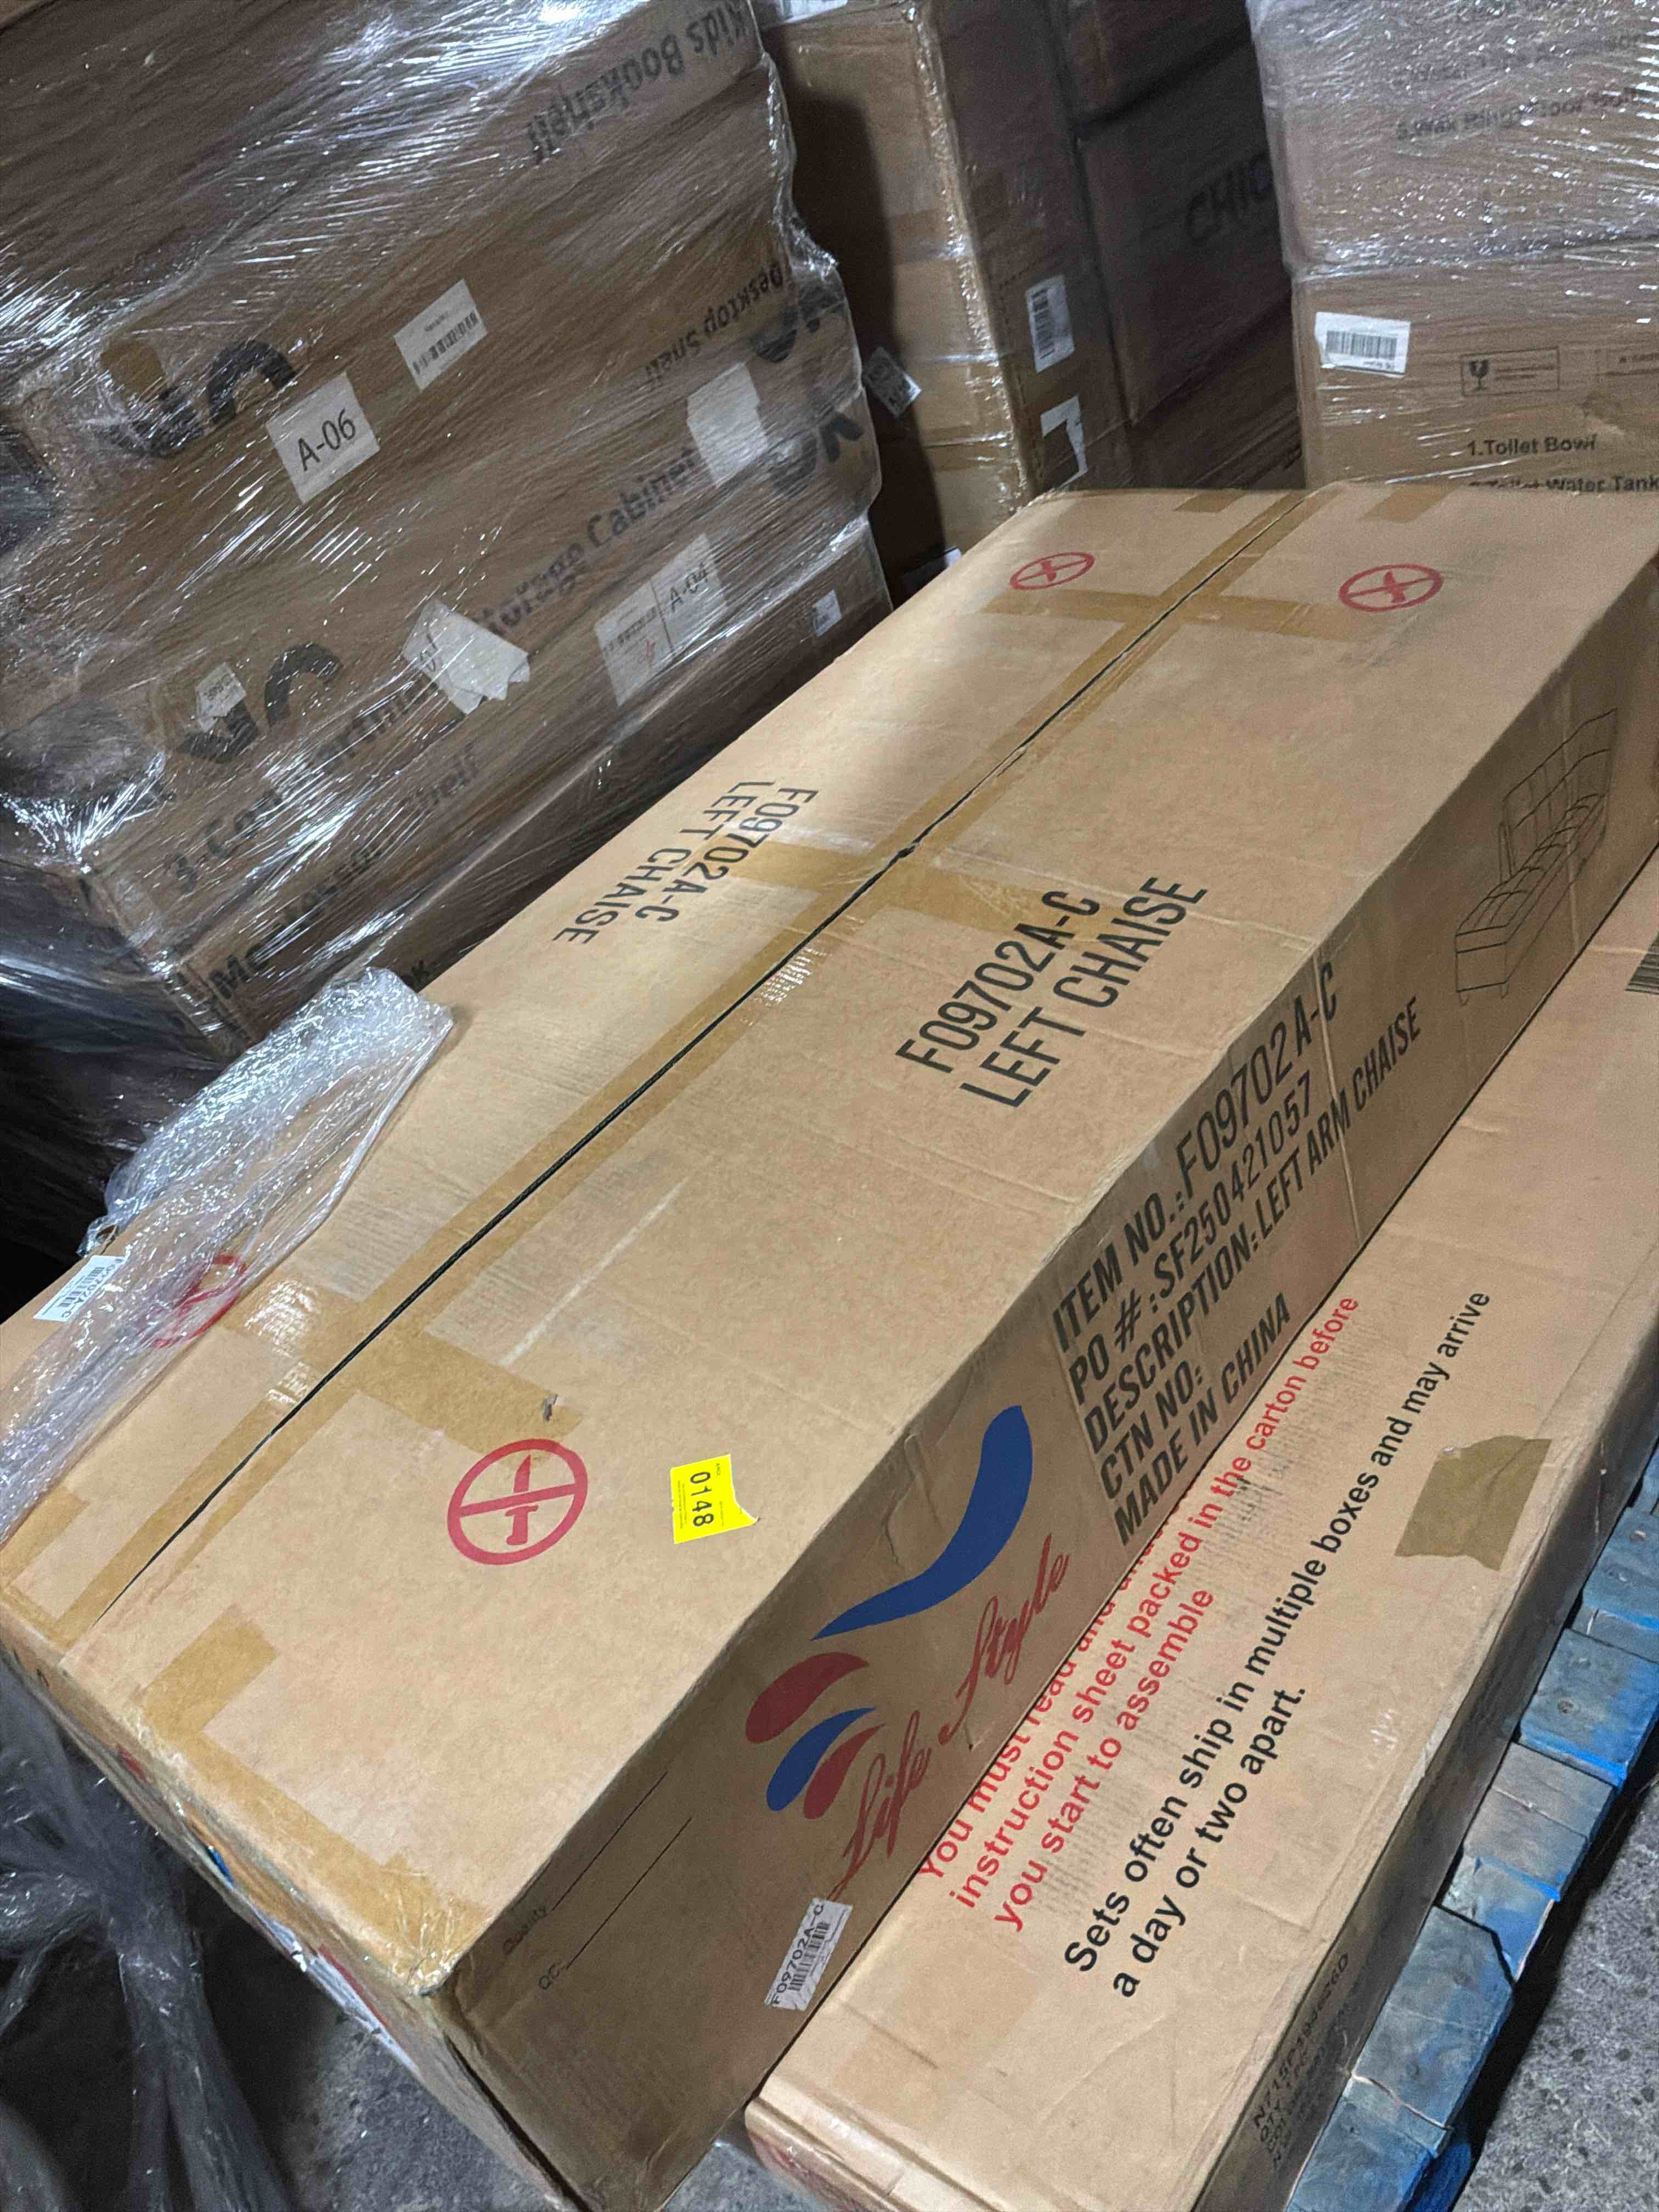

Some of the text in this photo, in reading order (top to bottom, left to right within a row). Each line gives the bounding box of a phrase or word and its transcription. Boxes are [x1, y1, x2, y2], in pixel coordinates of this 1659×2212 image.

[297, 409, 356, 471] A-06
[483, 542, 587, 636] torage
[552, 781, 775, 945] LEFT CHAISE
[636, 788, 818, 922] F09702A-C
[895, 890, 1101, 1073] F09702A-C
[960, 877, 1207, 1107] LEFT CHAISE
[1306, 1088, 1352, 1176] ARM
[1352, 996, 1421, 1112] CHAISE
[1052, 1244, 1124, 1353] ITEM
[1069, 1333, 1110, 1405] PO
[690, 1471, 714, 1527] 0148
[1100, 1410, 1153, 1499] CTN
[1155, 1360, 1203, 1427] NO:
[1114, 1429, 1188, 1546] MADE
[1189, 1387, 1218, 1444] IN
[1221, 1292, 1291, 1403] CHINA
[949, 1729, 1079, 1908] instruction
[1073, 1639, 1135, 1723] sheet
[1126, 1533, 1202, 1638] packed
[1193, 1503, 1224, 1531] in
[1210, 1455, 1251, 1499] the
[1246, 1374, 1307, 1451] carton
[1293, 1296, 1359, 1371] before
[1064, 1292, 1491, 1972] Sets often ship in multiple boxes and may arrive
[827, 1533, 1070, 1900] Life Style
[994, 1860, 1048, 1932] you
[1042, 1774, 1101, 1853] start
[1086, 1737, 1122, 1771] to
[1116, 1589, 1214, 1731] assemble
[918, 1819, 974, 1879] You
[968, 1733, 1030, 1812] must
[1113, 1688, 1306, 1997] a day or two apart.
[772, 1904, 823, 2005] F09702A-C
